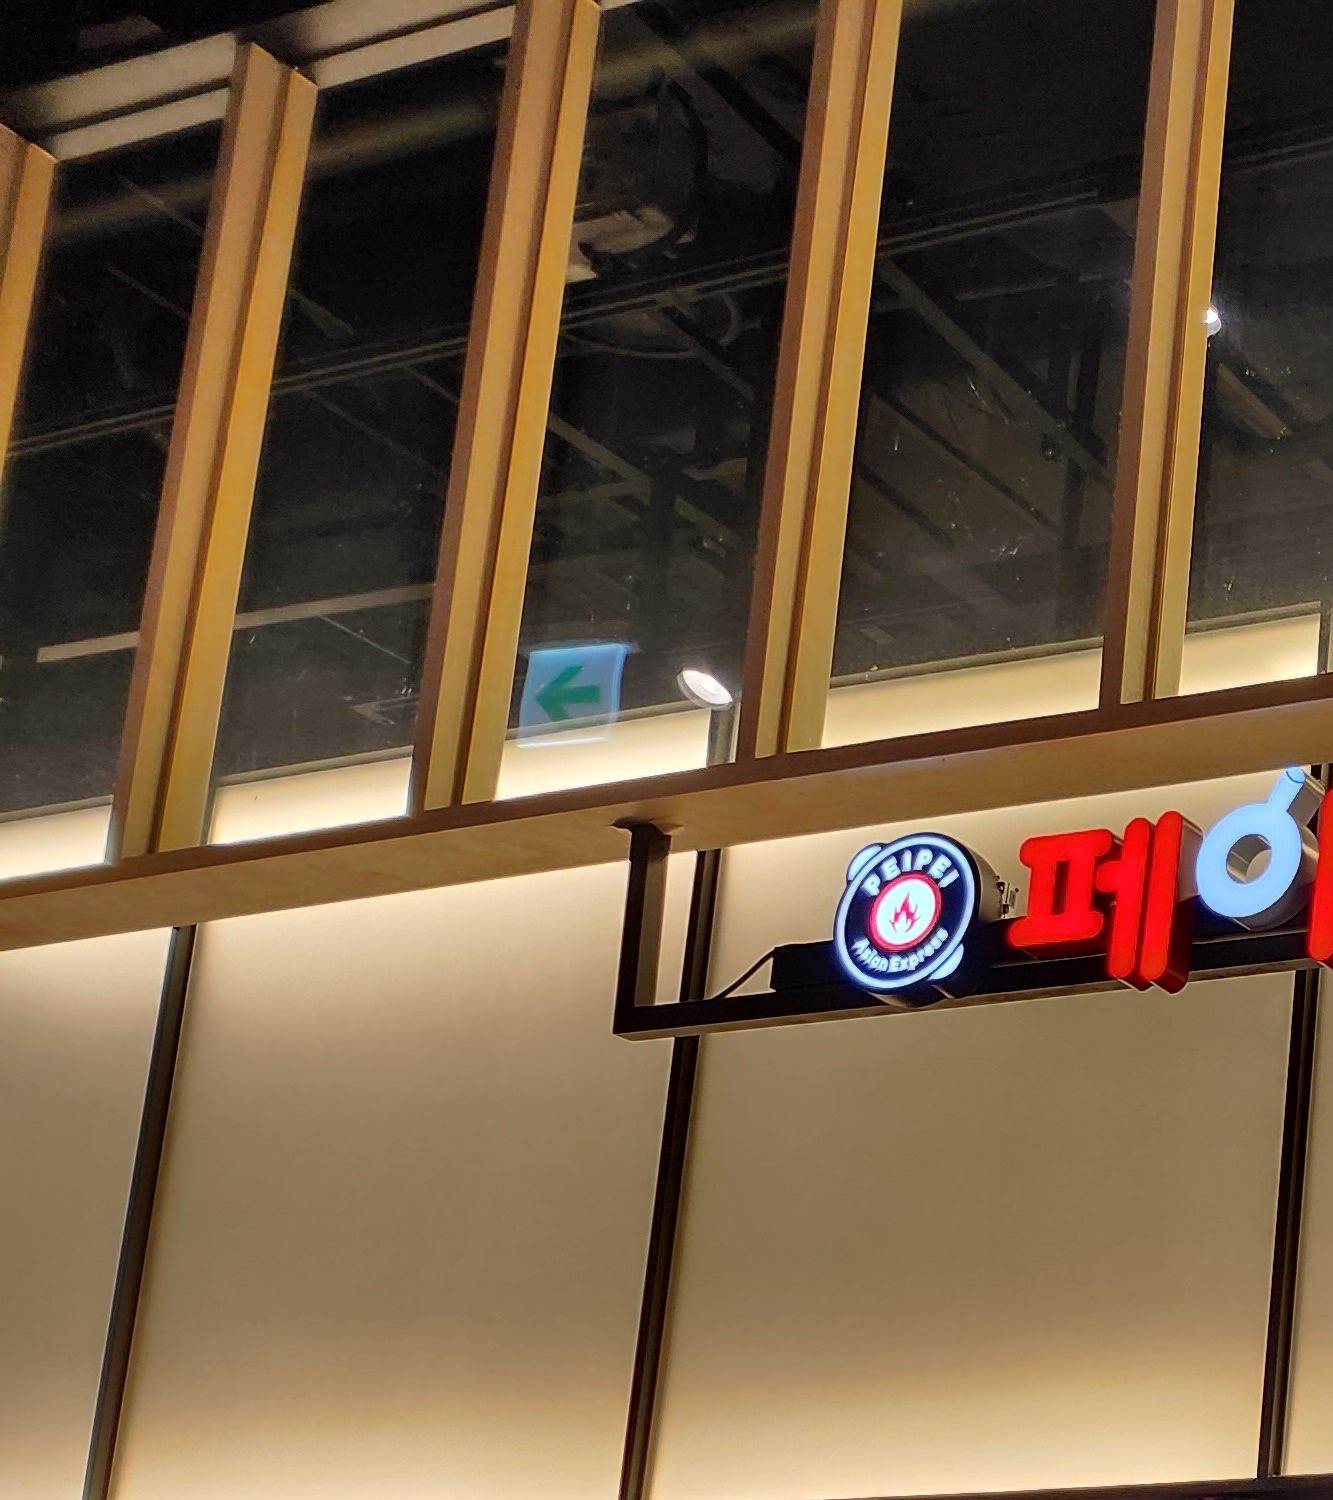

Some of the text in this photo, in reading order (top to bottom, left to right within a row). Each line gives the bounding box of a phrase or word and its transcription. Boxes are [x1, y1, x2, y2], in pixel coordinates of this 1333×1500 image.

[861, 848, 960, 897] PEIPEI
[852, 927, 949, 973] Asian Express
